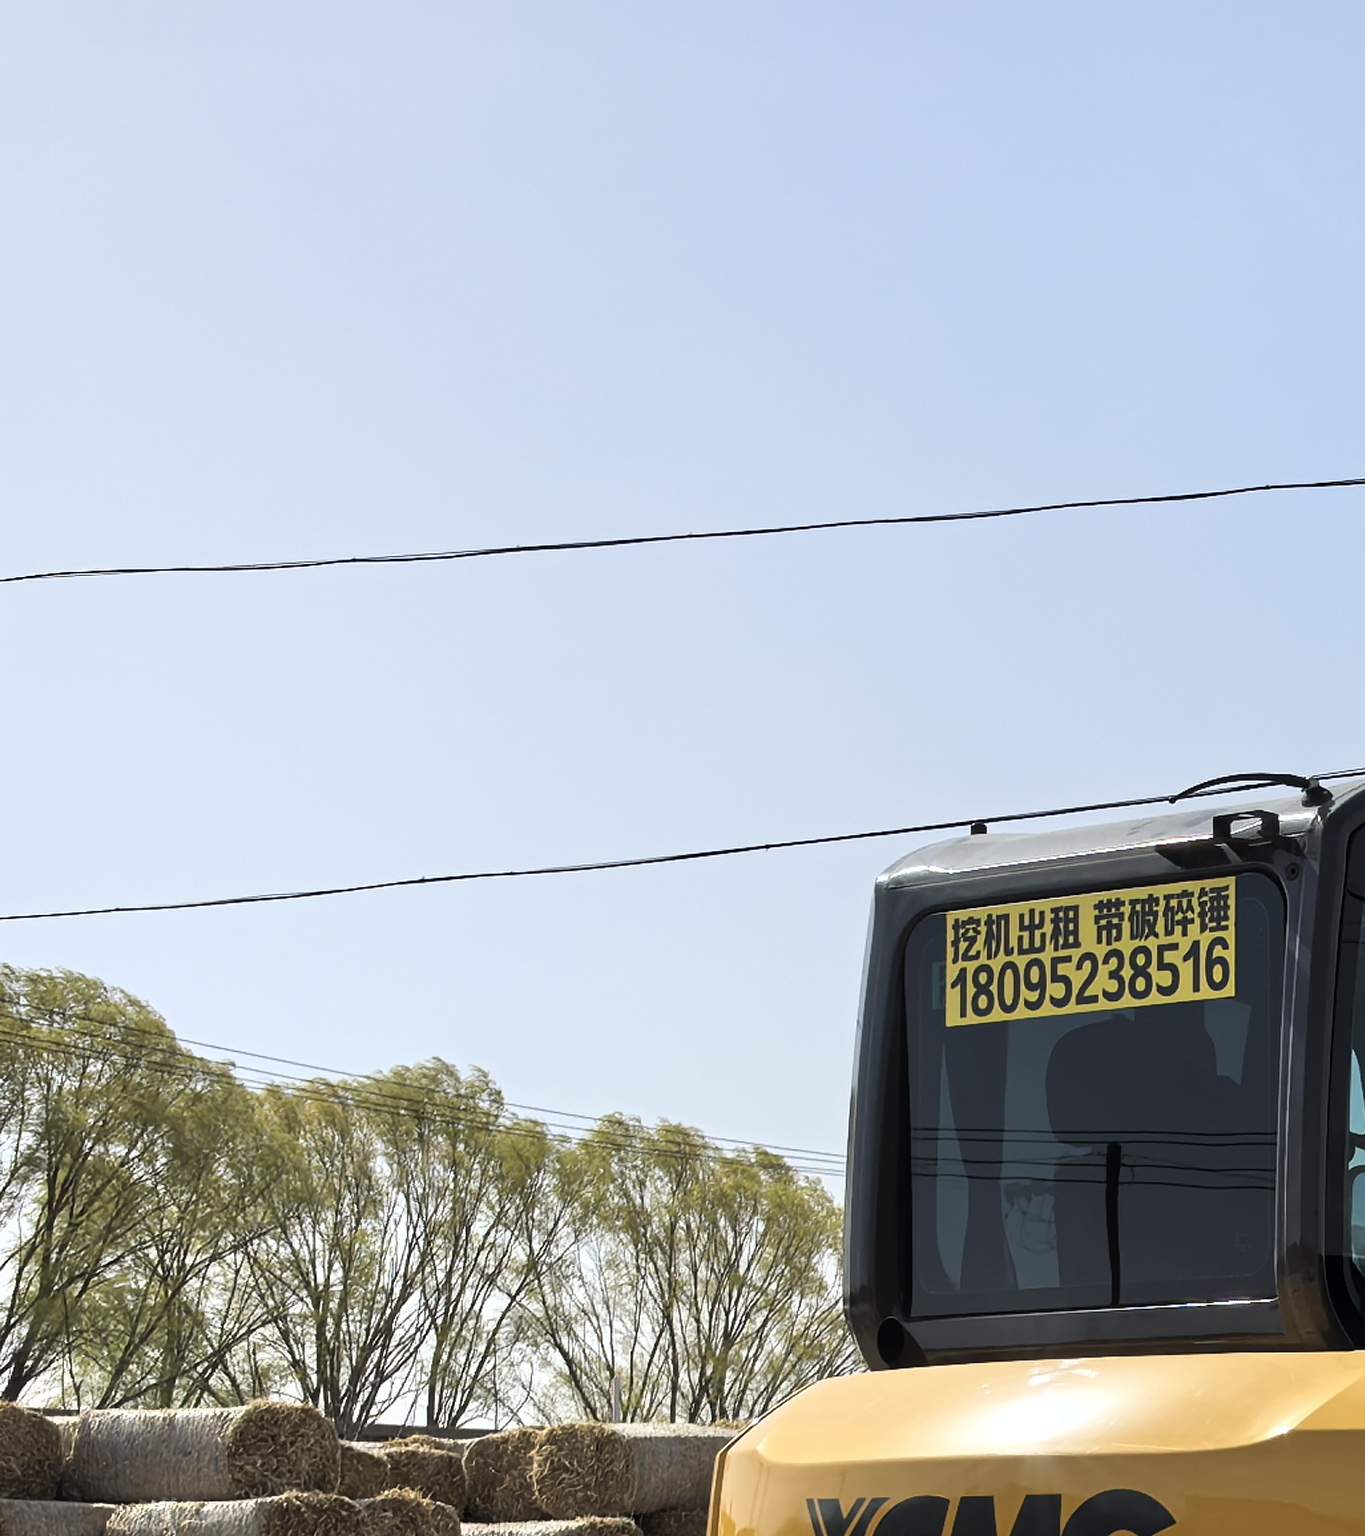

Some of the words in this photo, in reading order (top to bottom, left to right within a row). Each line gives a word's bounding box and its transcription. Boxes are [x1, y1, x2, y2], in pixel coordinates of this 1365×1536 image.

[951, 904, 1082, 964] 挖机出租
[1093, 884, 1230, 946] 带破碎锤
[951, 936, 1230, 1018] 18095238516
